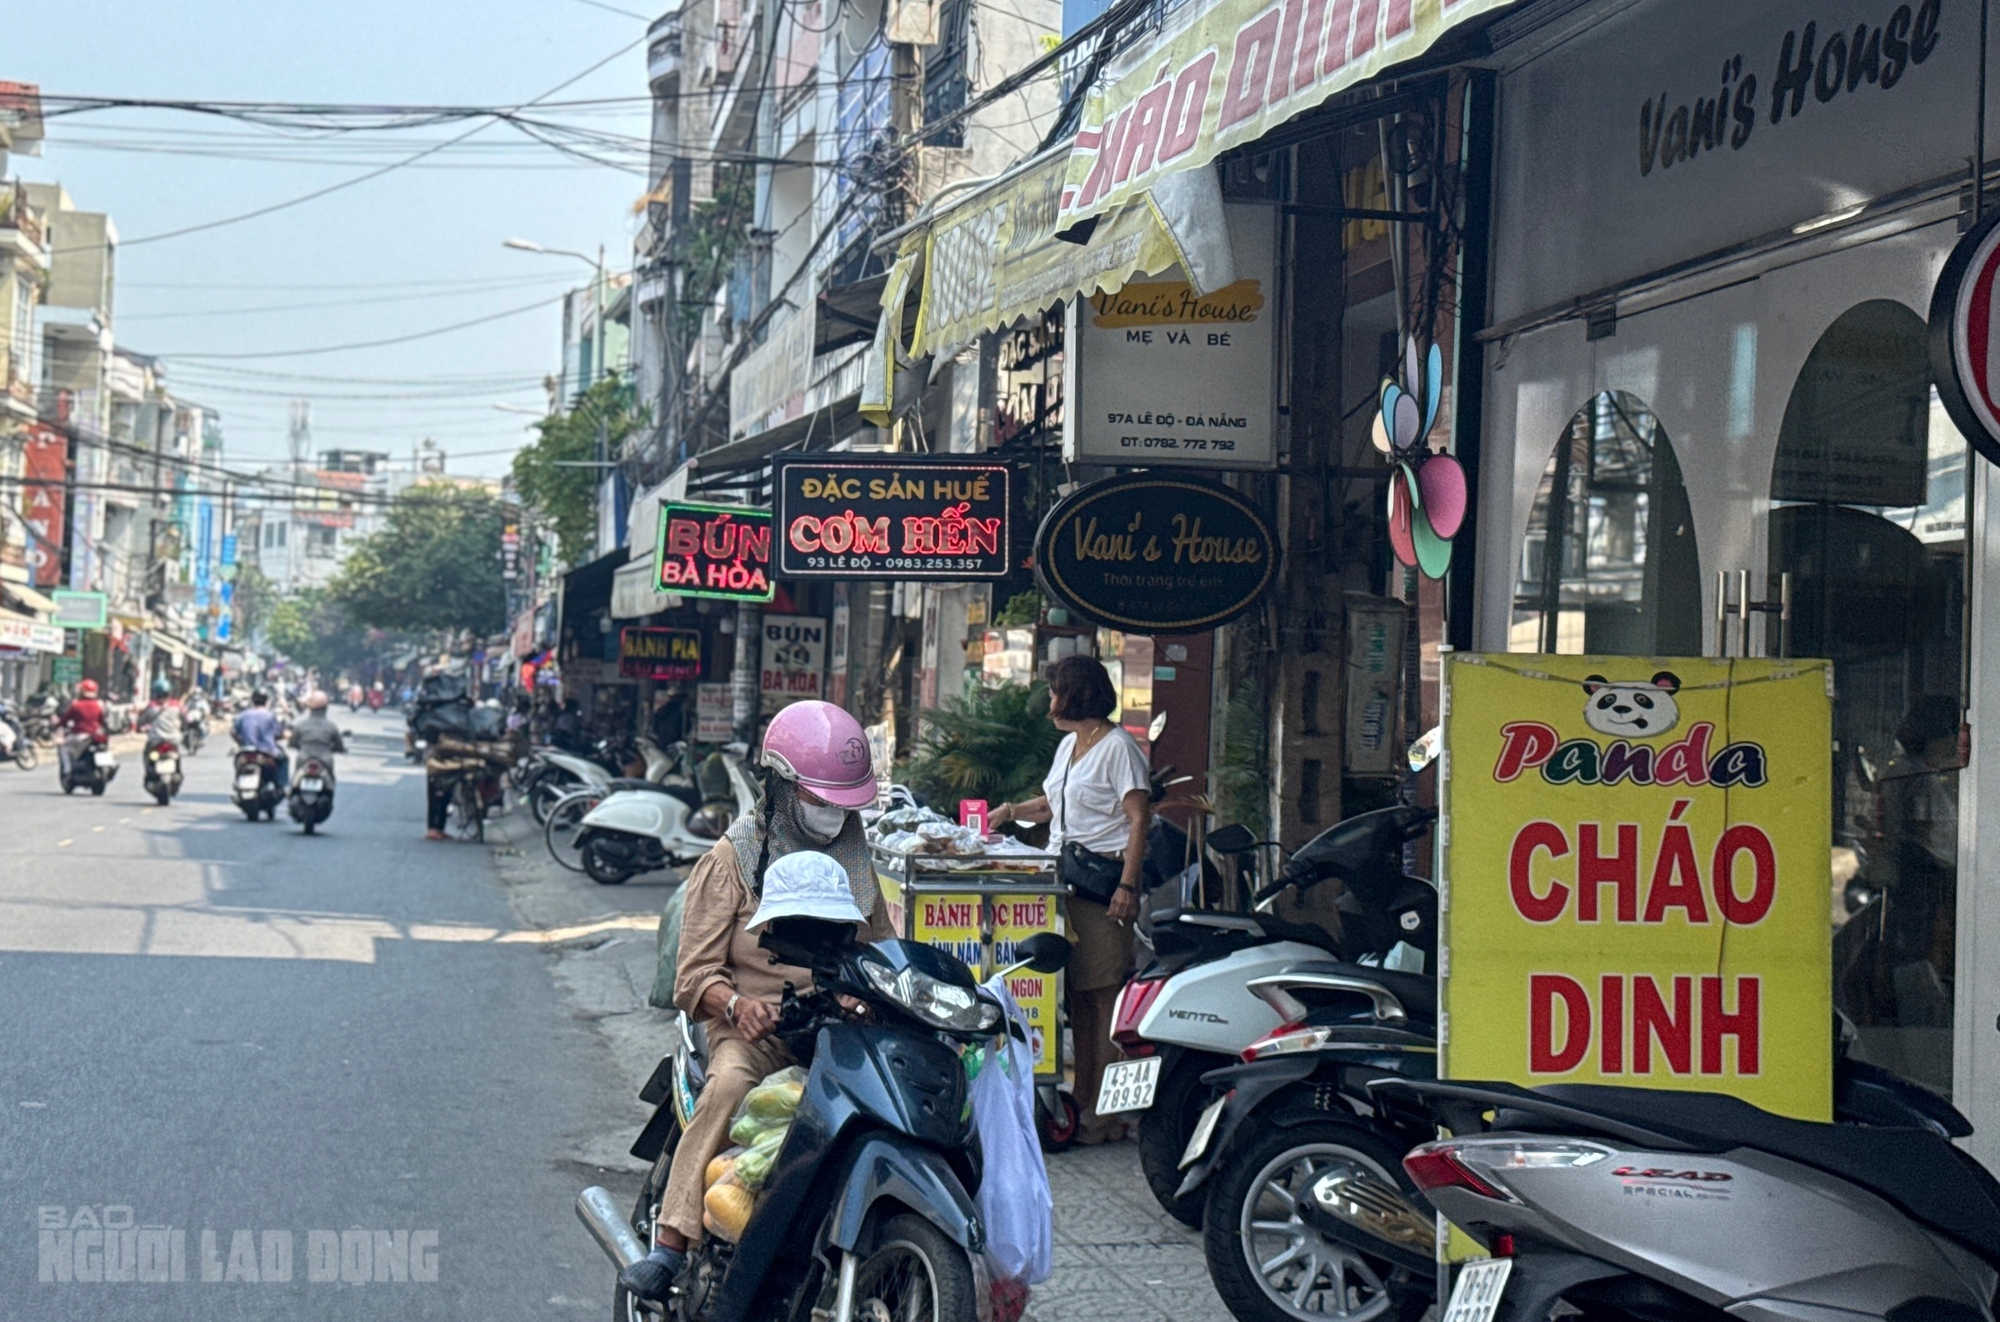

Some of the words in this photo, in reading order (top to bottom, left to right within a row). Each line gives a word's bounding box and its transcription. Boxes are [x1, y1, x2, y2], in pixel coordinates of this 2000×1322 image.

[1640, 54, 1757, 177] Vani's
[1770, 0, 1942, 125] House
[1097, 289, 1175, 317] Vani's
[1179, 288, 1254, 321] House
[1126, 330, 1153, 345] MẸ
[1167, 329, 1191, 344] VÀ
[1207, 331, 1231, 346] BÉ
[1108, 413, 1133, 424] 97A
[1138, 411, 1153, 424] LÊ
[1156, 412, 1175, 428] ĐỘ
[1183, 439, 1207, 450] 772
[1210, 440, 1235, 450] 792
[801, 473, 862, 502] ĐẶC
[869, 472, 925, 499] SẢN
[934, 472, 990, 500] HUẾ
[668, 514, 770, 562] BÚN
[789, 509, 891, 554] CƠM
[902, 502, 1001, 555] HẾN
[1074, 511, 1162, 561] Vani's
[1172, 513, 1263, 564] House
[661, 554, 701, 586] BÀ
[706, 558, 768, 591] HÒA
[807, 557, 826, 568] 93
[829, 555, 846, 568] LÊ
[850, 555, 871, 570] ĐỘ
[885, 557, 983, 569] 0983.253.357
[766, 622, 822, 643] BÚN
[1493, 720, 1769, 788] Panda
[1508, 799, 1776, 925] CHÁO
[924, 897, 972, 926] BÁNH
[1012, 895, 1047, 926] HUẾ
[1012, 978, 1043, 998] NGON
[1169, 1009, 1229, 1024] VENTO
[1530, 975, 1760, 1075] DINH
[1111, 1062, 1150, 1087] 43-AA
[1101, 1083, 1153, 1111] 789.92
